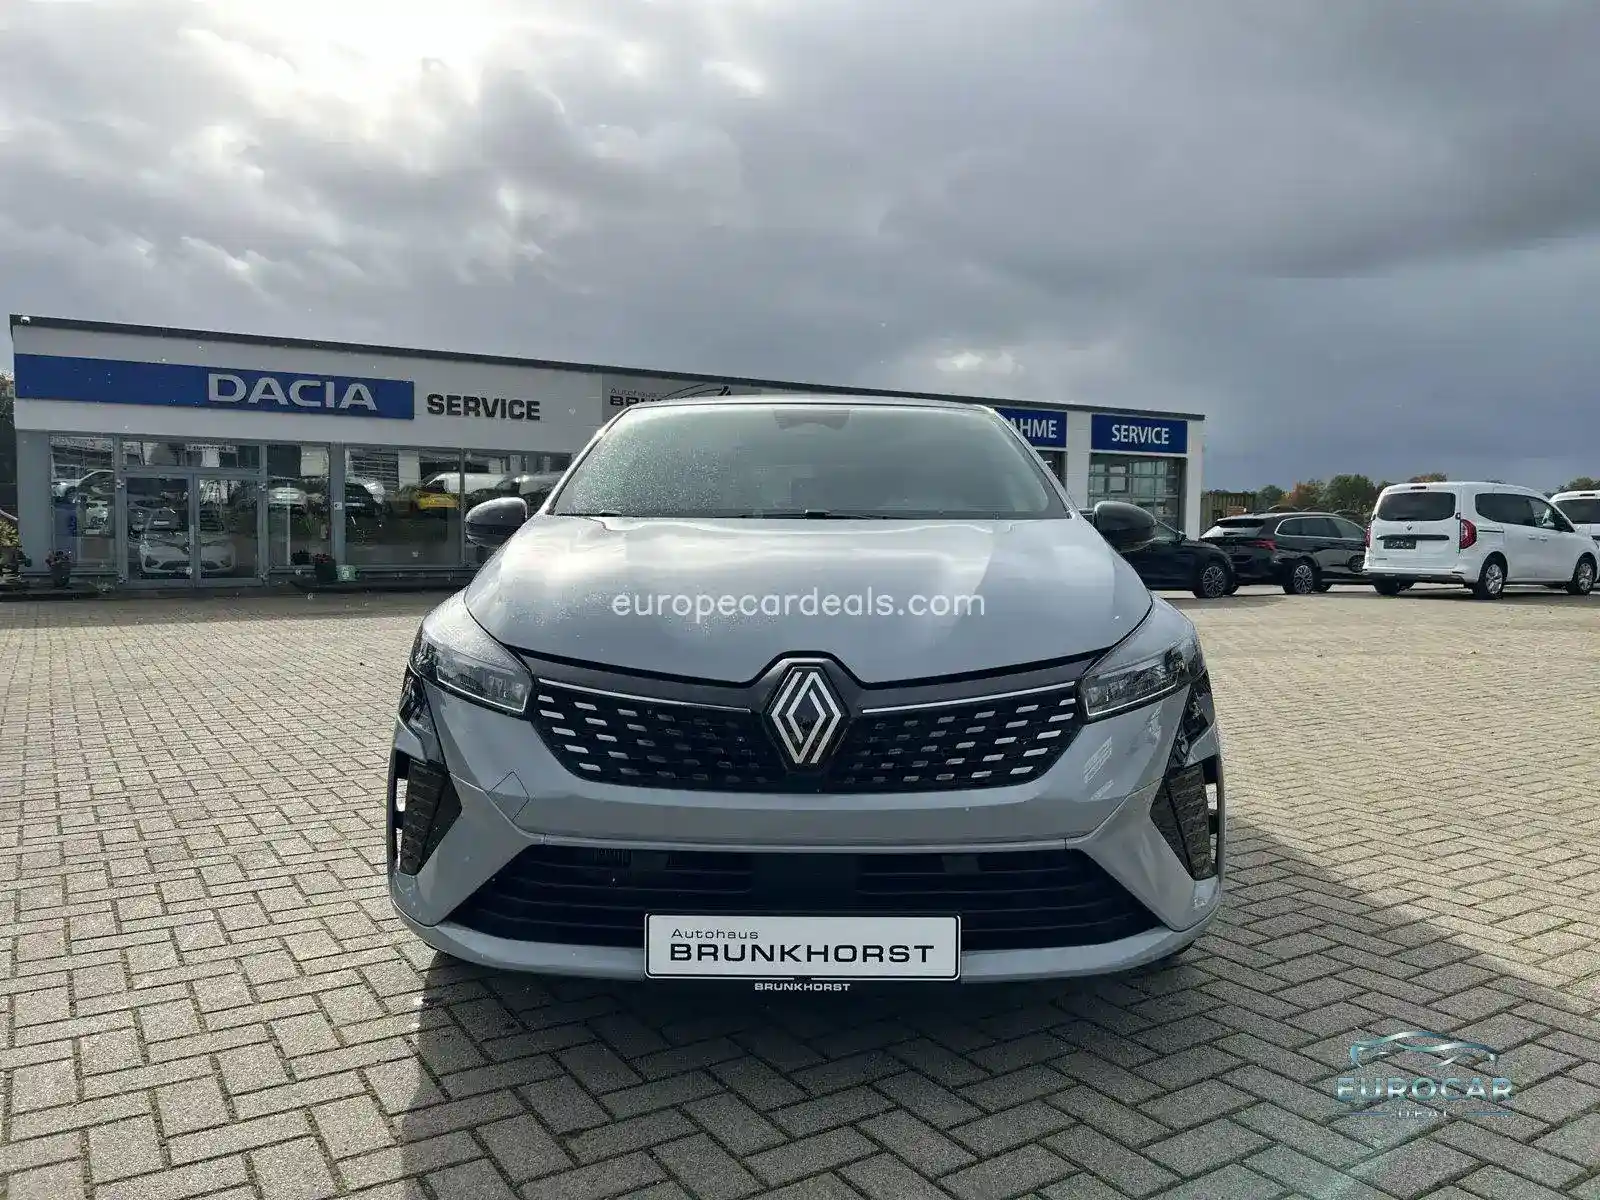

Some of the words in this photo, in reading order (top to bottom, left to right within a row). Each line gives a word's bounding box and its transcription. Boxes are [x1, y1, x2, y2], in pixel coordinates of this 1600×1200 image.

[208, 373, 378, 411] DACIA
[426, 393, 541, 421] SERVICE
[1111, 424, 1170, 445] SERVICE
[671, 928, 759, 940] Autohaus
[670, 943, 935, 963] BRUNKHORST
[754, 982, 851, 992] BRUNKHORST
